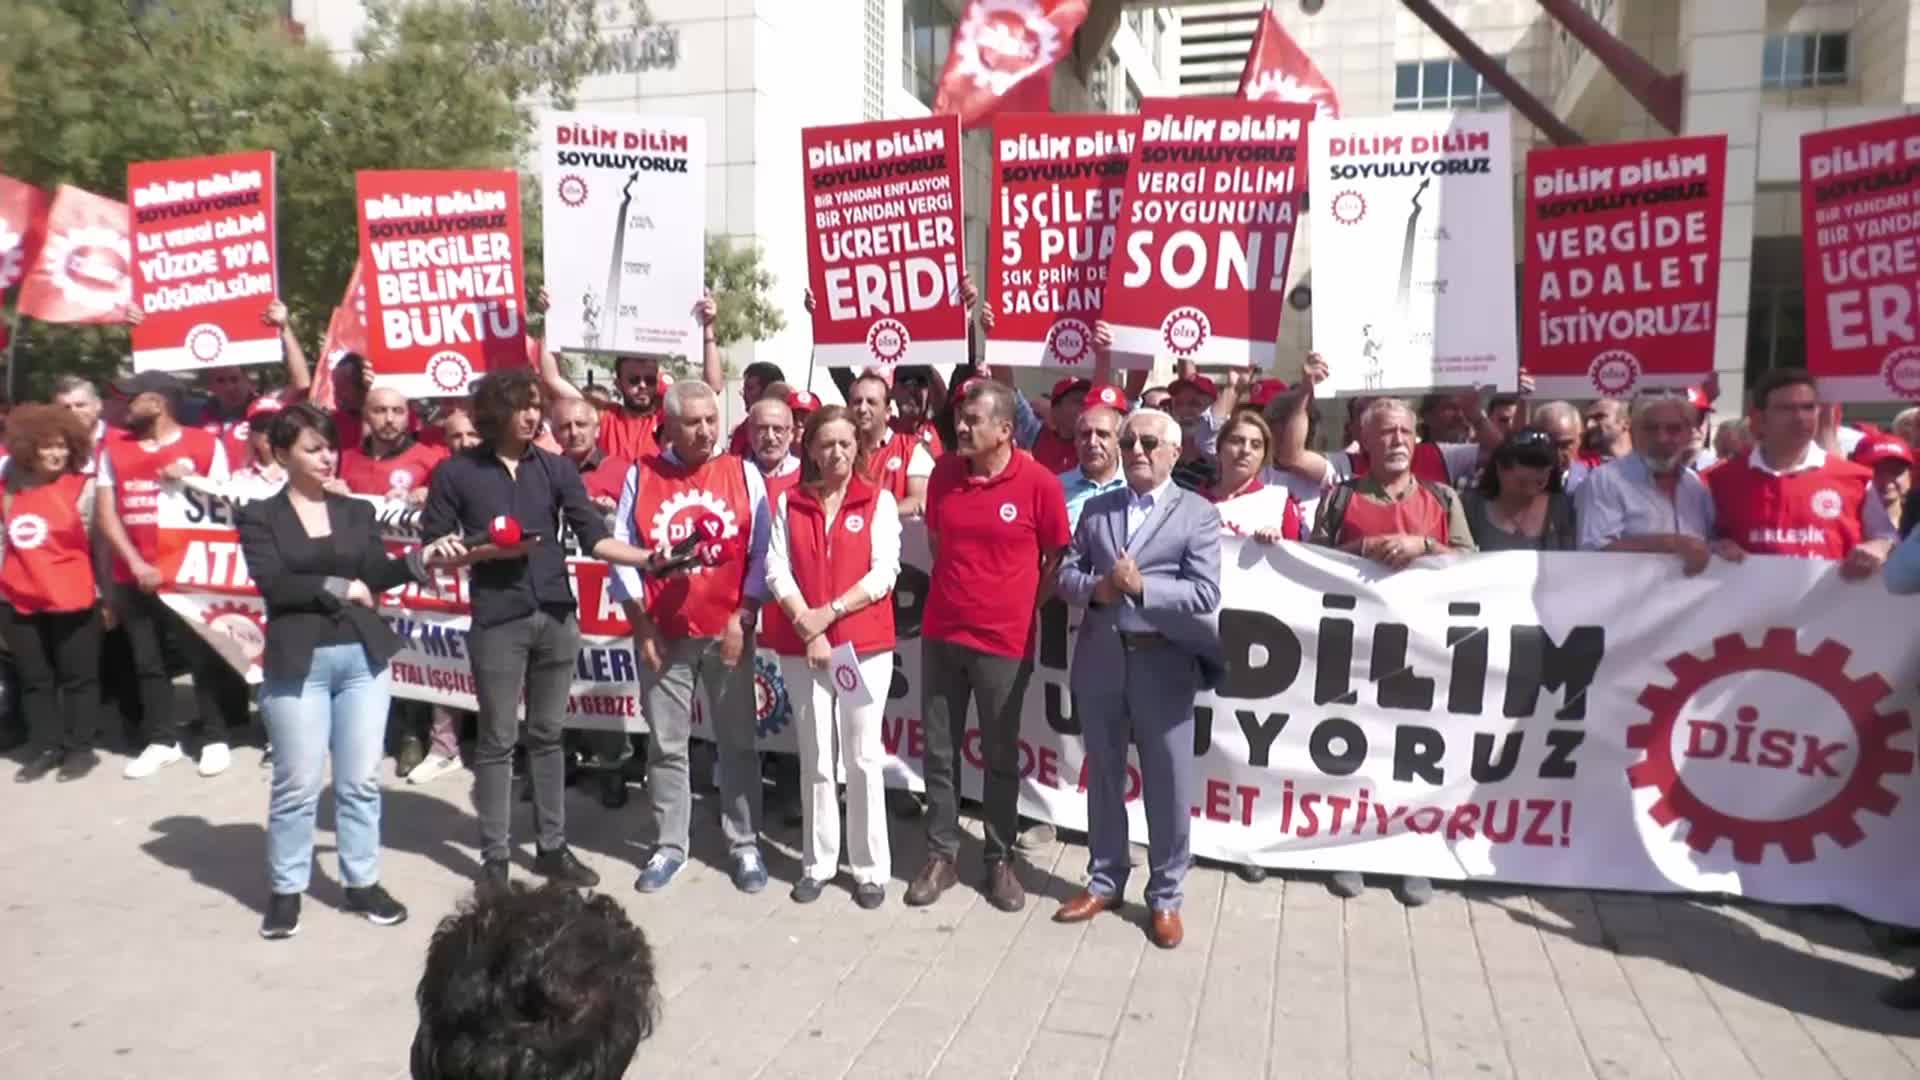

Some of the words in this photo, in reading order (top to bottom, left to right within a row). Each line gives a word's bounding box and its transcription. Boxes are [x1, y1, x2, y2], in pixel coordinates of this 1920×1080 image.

[556, 123, 617, 149] DİLİM
[623, 128, 688, 153] DİLİM
[1142, 114, 1217, 142] DİLİM
[1220, 114, 1301, 142] DİLİM
[1329, 132, 1403, 157] DİLİM
[1411, 129, 1490, 154] DİLİM
[557, 151, 689, 173] SOYULUYORUZ
[807, 140, 872, 169] DİLİM
[876, 128, 945, 160] DİLİM
[1000, 133, 1071, 161] DİLİM
[1141, 146, 1297, 165] SOYULUYORUZ
[1809, 140, 1896, 180] DİLİM
[813, 154, 947, 189] SOYULUYORUZ
[1137, 167, 1206, 193] VERGİ
[1215, 166, 1296, 193] DİLİMİ
[1330, 157, 1491, 181] SOYULUYORUZ
[1533, 166, 1613, 198] DİLİM
[1619, 153, 1707, 187] DİLİM
[134, 180, 195, 208] DİLİM
[197, 170, 262, 194] DİLİM
[365, 193, 433, 220] DİLİM
[435, 188, 507, 215] DİLİM
[814, 193, 834, 209] BİR
[834, 184, 882, 205] YANDAN
[883, 175, 950, 199] ENFLASYON
[1001, 184, 1126, 230] İŞÇİLER
[1537, 181, 1708, 220] SOYULUYORUZ
[1845, 191, 1909, 216] YANDAN
[137, 192, 261, 225] SOYULUYORUZ
[369, 214, 507, 239] SOYULUYORUZ
[815, 208, 841, 229] BİR
[843, 199, 905, 225] YANDAN
[908, 192, 954, 215] VERGİ
[1131, 200, 1293, 224] SOYGUNUNA
[137, 230, 164, 252] İLK
[165, 222, 214, 249] VERGİ
[819, 216, 955, 263] ÜCRETLER
[1002, 229, 1022, 265] 5
[1040, 225, 1117, 265] PUA
[1536, 211, 1706, 262] VERGİDE
[1817, 227, 1849, 247] BİR
[1854, 210, 1920, 239] YANDA
[139, 250, 219, 283] YÜZDE
[370, 232, 512, 271] VERGİLER
[1123, 230, 1290, 291] SON!
[1821, 235, 1920, 285] ÜCRE
[376, 264, 515, 306] BELİMİZİ
[824, 252, 961, 321] ERİDİ
[1002, 265, 1032, 287] SGK
[1039, 264, 1080, 283] PRİM
[1087, 265, 1107, 281] DE
[1539, 253, 1708, 302] ADALET
[1002, 284, 1101, 315] SAĞLAN
[1826, 280, 1920, 350] ER
[382, 299, 519, 350] BÜKTÜ
[1539, 301, 1711, 347] İSTİYORUZ!
[1212, 592, 1605, 720] DİLİM
[391, 660, 425, 686] ETAL
[426, 663, 479, 696] İŞÇİLE
[1683, 704, 1849, 777] DİSK
[1279, 779, 1573, 848] İSTİYORUZ!
